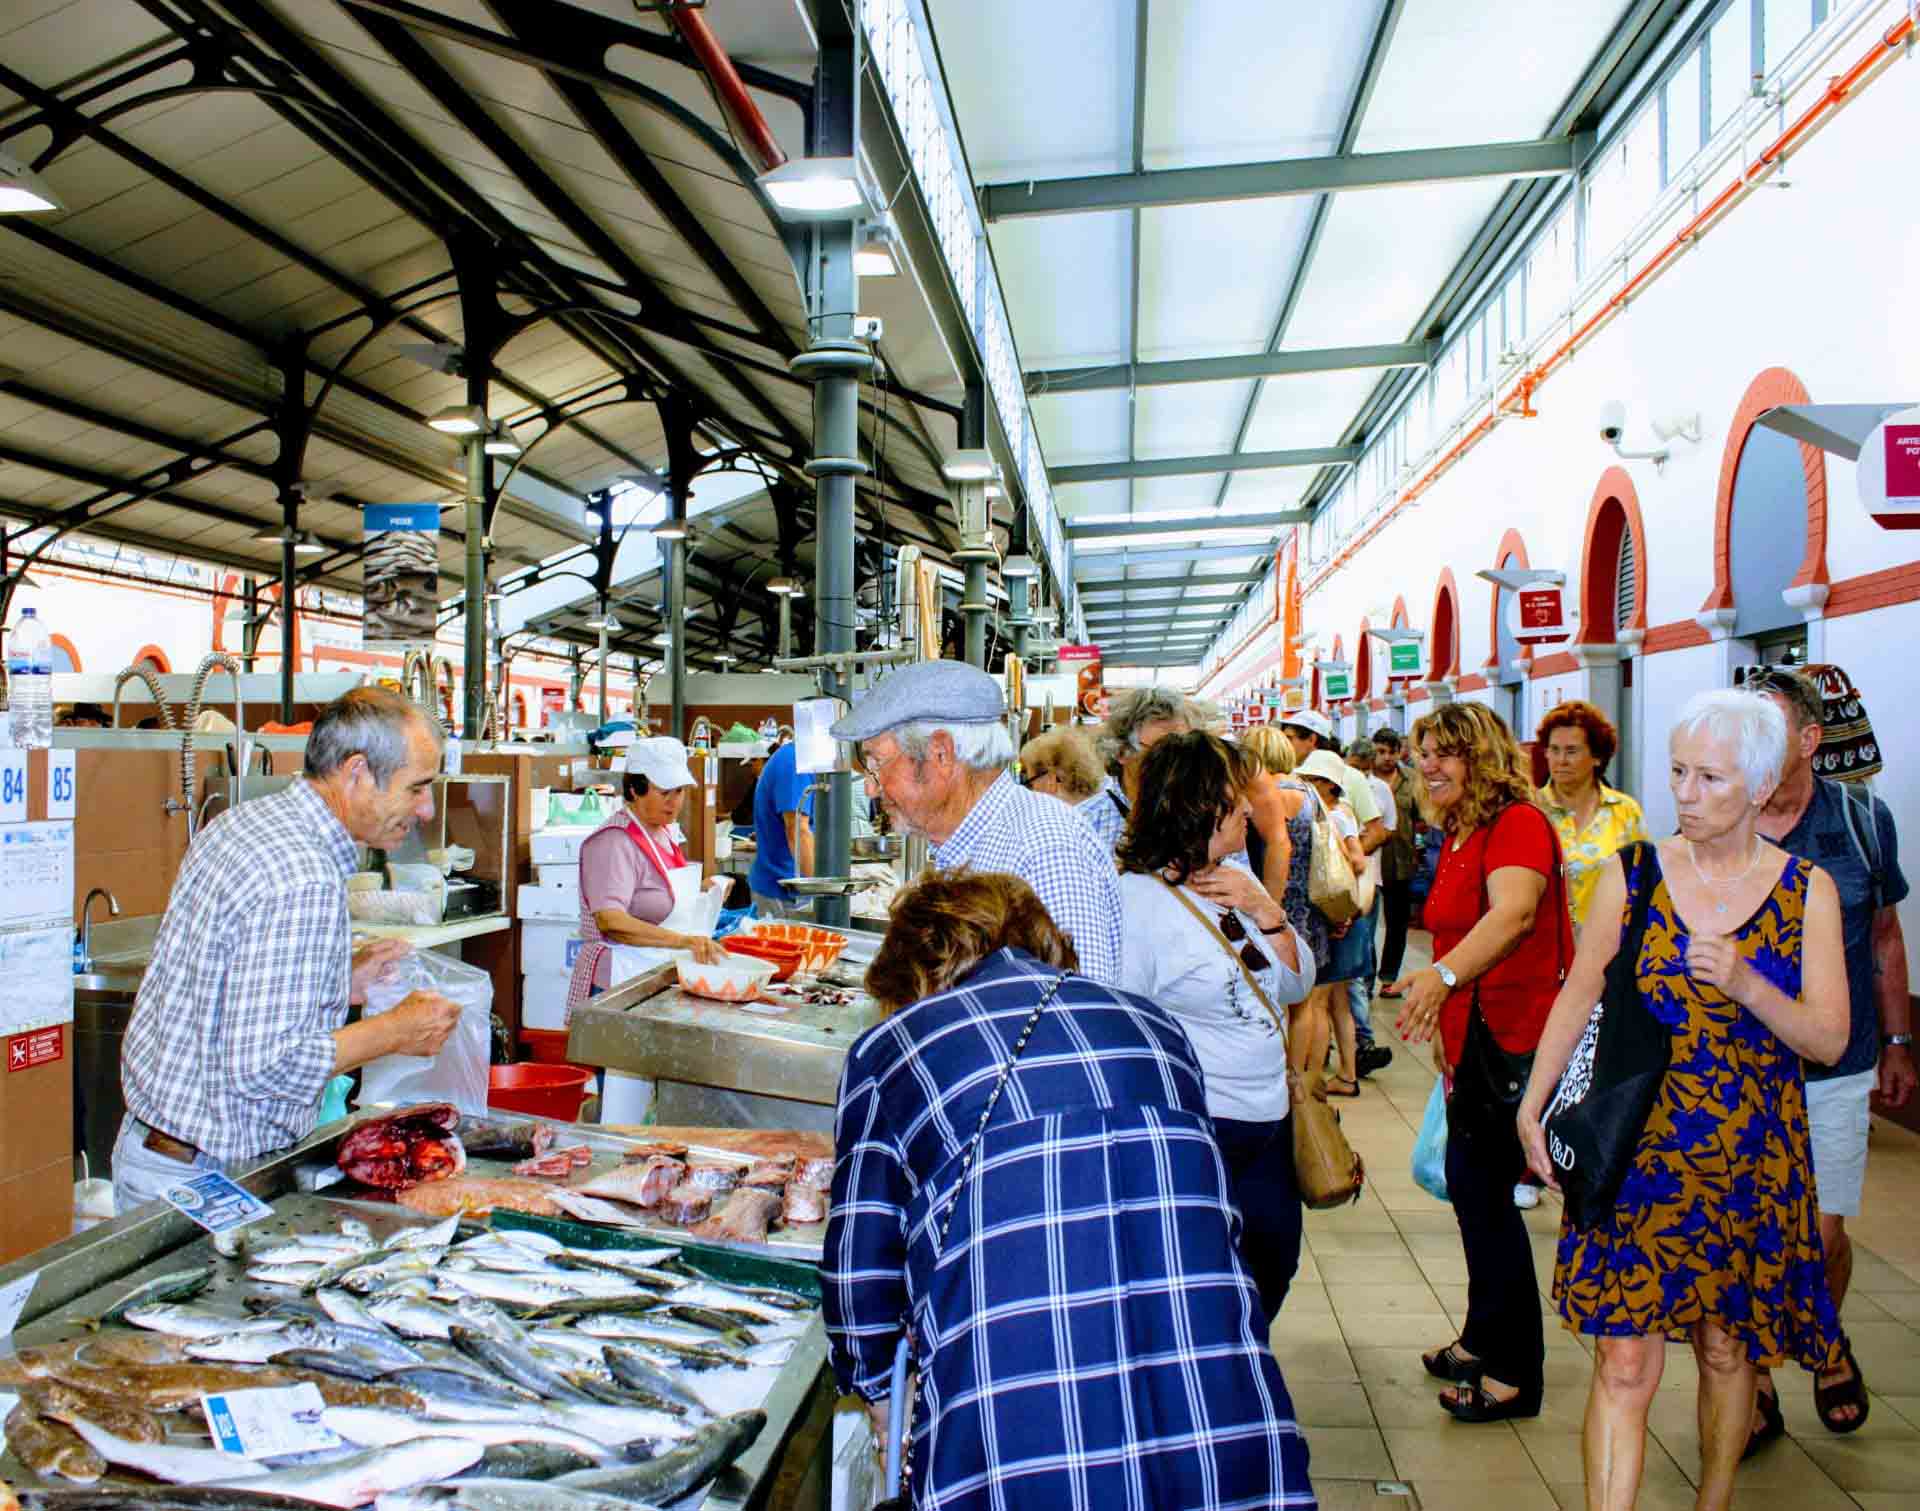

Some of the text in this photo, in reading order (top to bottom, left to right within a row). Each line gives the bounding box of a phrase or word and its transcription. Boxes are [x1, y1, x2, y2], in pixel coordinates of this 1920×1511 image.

[3, 767, 23, 803] 84
[53, 767, 72, 801] 85
[1550, 1129, 1575, 1170] V&D
